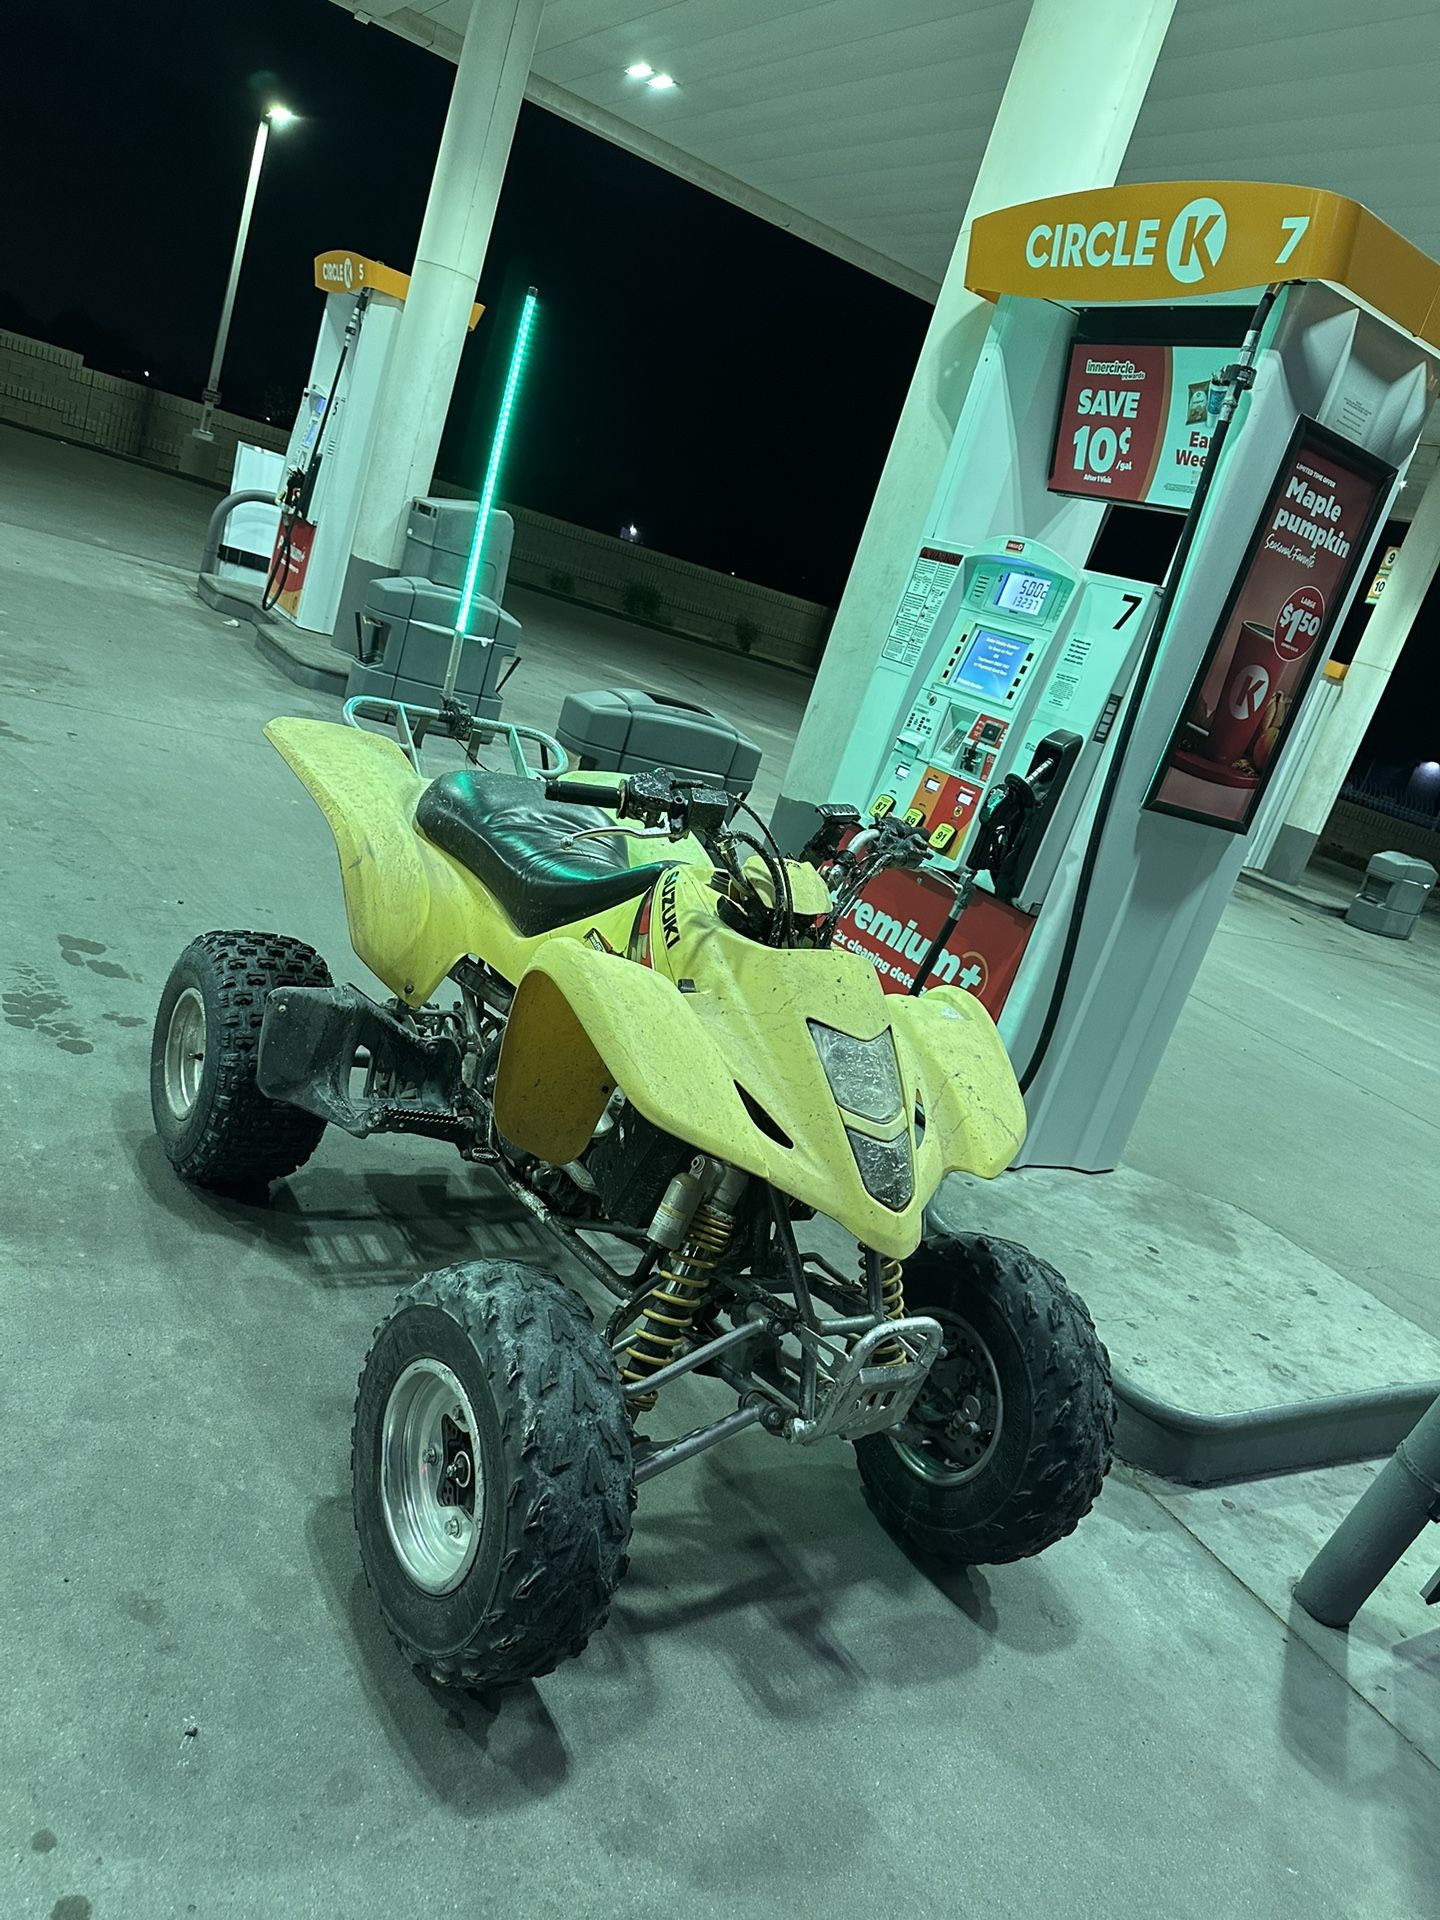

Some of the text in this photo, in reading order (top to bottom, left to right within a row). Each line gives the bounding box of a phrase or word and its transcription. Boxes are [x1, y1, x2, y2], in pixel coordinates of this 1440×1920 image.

[1025, 208, 1224, 281] CIRCLE K
[1274, 215, 1311, 265] 7
[322, 258, 353, 288] CIRCLE K
[358, 262, 365, 281] 5
[1086, 359, 1136, 374] innercircle
[1077, 388, 1141, 419] SAVE
[1189, 430, 1211, 449] Ea
[1175, 448, 1208, 468] Wee
[1285, 475, 1342, 523] Maple
[1271, 507, 1351, 559] pumpkin
[1387, 551, 1397, 565] 9
[1374, 580, 1386, 594] 10
[1112, 593, 1143, 631] 7
[1232, 669, 1268, 718] K
[875, 801, 888, 813] 87
[935, 830, 948, 842] 91
[661, 870, 681, 950] SUZUKI
[843, 898, 983, 990] remium+
[832, 929, 919, 992] 2x cleaning dete
